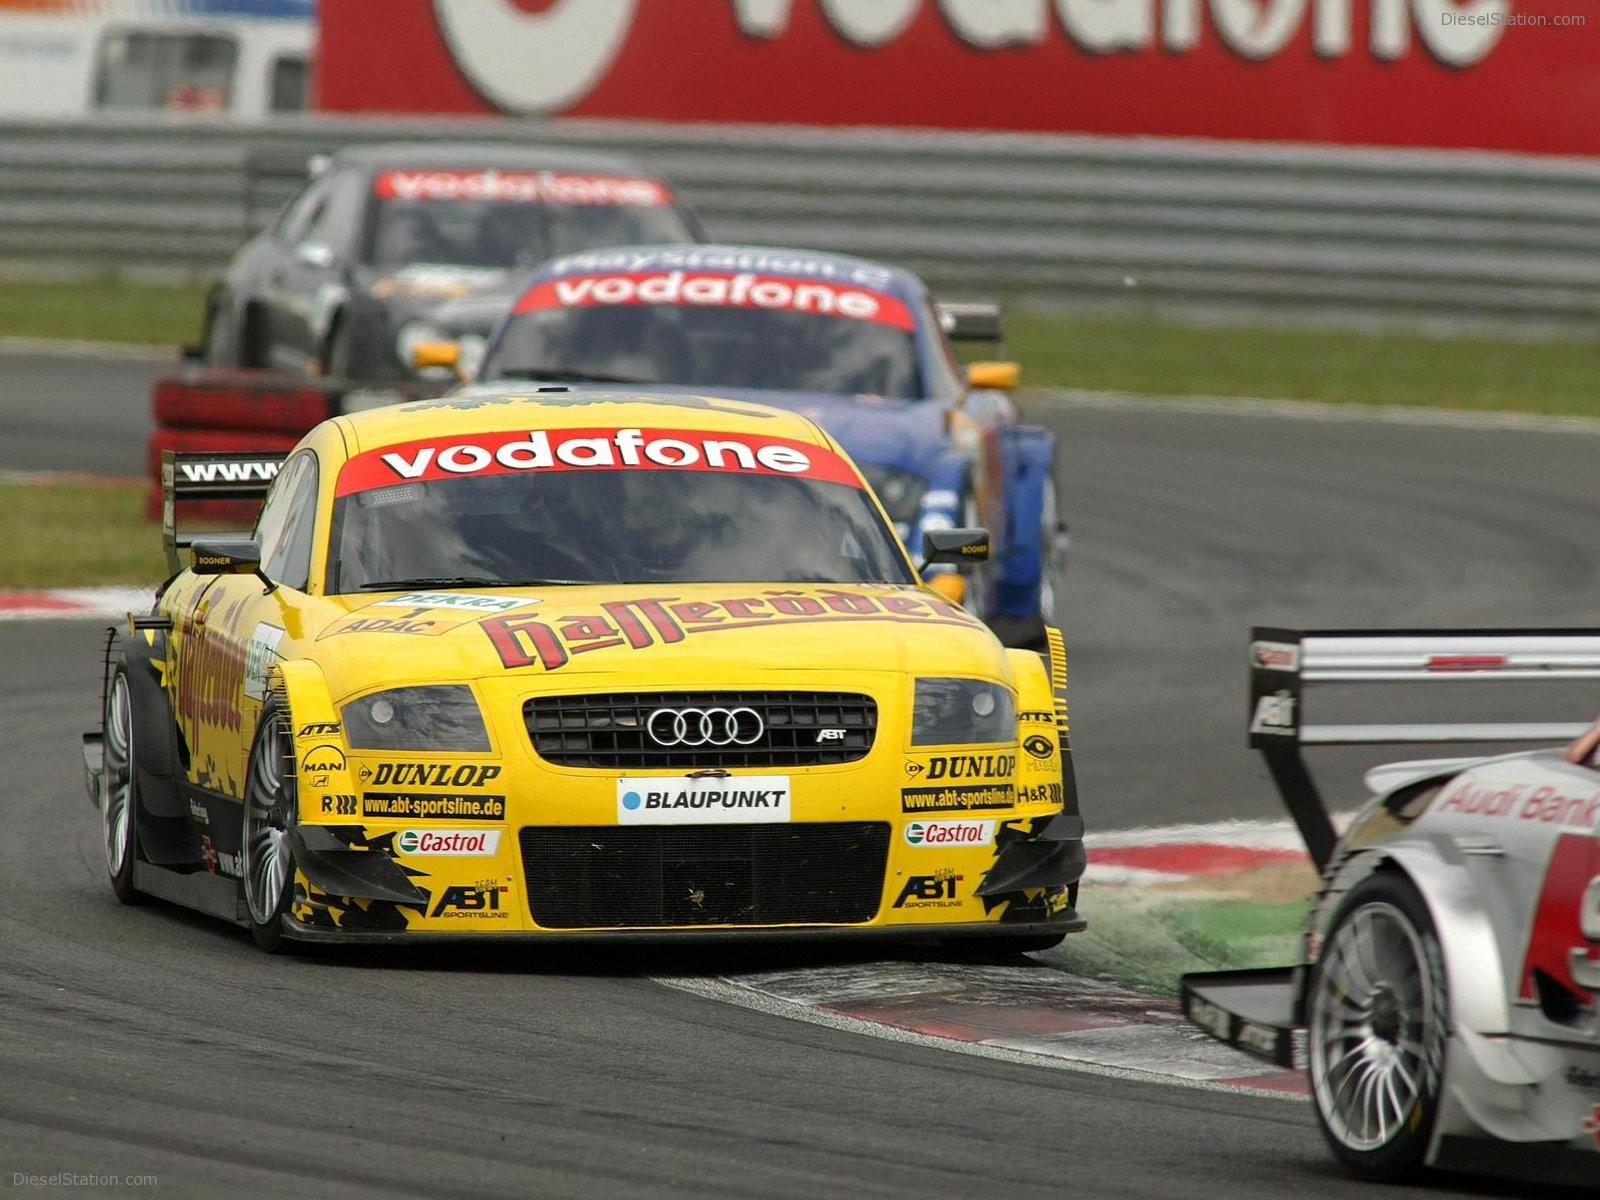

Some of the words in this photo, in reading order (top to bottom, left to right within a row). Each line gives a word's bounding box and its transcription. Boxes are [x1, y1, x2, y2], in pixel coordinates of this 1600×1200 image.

[555, 270, 881, 319] vodafone
[380, 428, 811, 479] vodafone
[199, 557, 231, 565] BOGNER
[386, 592, 521, 609] DEKRA
[337, 618, 437, 633] ADAC
[1016, 711, 1054, 723] ATS
[298, 721, 342, 738] ATS
[816, 729, 847, 743] ABT
[304, 762, 343, 773] MAN
[372, 763, 502, 787] DUNLOP
[926, 755, 1016, 780] DUNLOP
[645, 790, 786, 809] BLAUPUNKT
[1017, 785, 1048, 803] H&R
[1437, 781, 1531, 816] Audi
[364, 796, 502, 818] www.abt-sportsline.de
[420, 832, 486, 852] Castrol
[925, 823, 984, 843] Castrol
[892, 875, 964, 908] ABT
[431, 885, 508, 918] ABT
[904, 900, 963, 909] SPORTSLINE
[443, 911, 509, 919] SPORTSLINE
